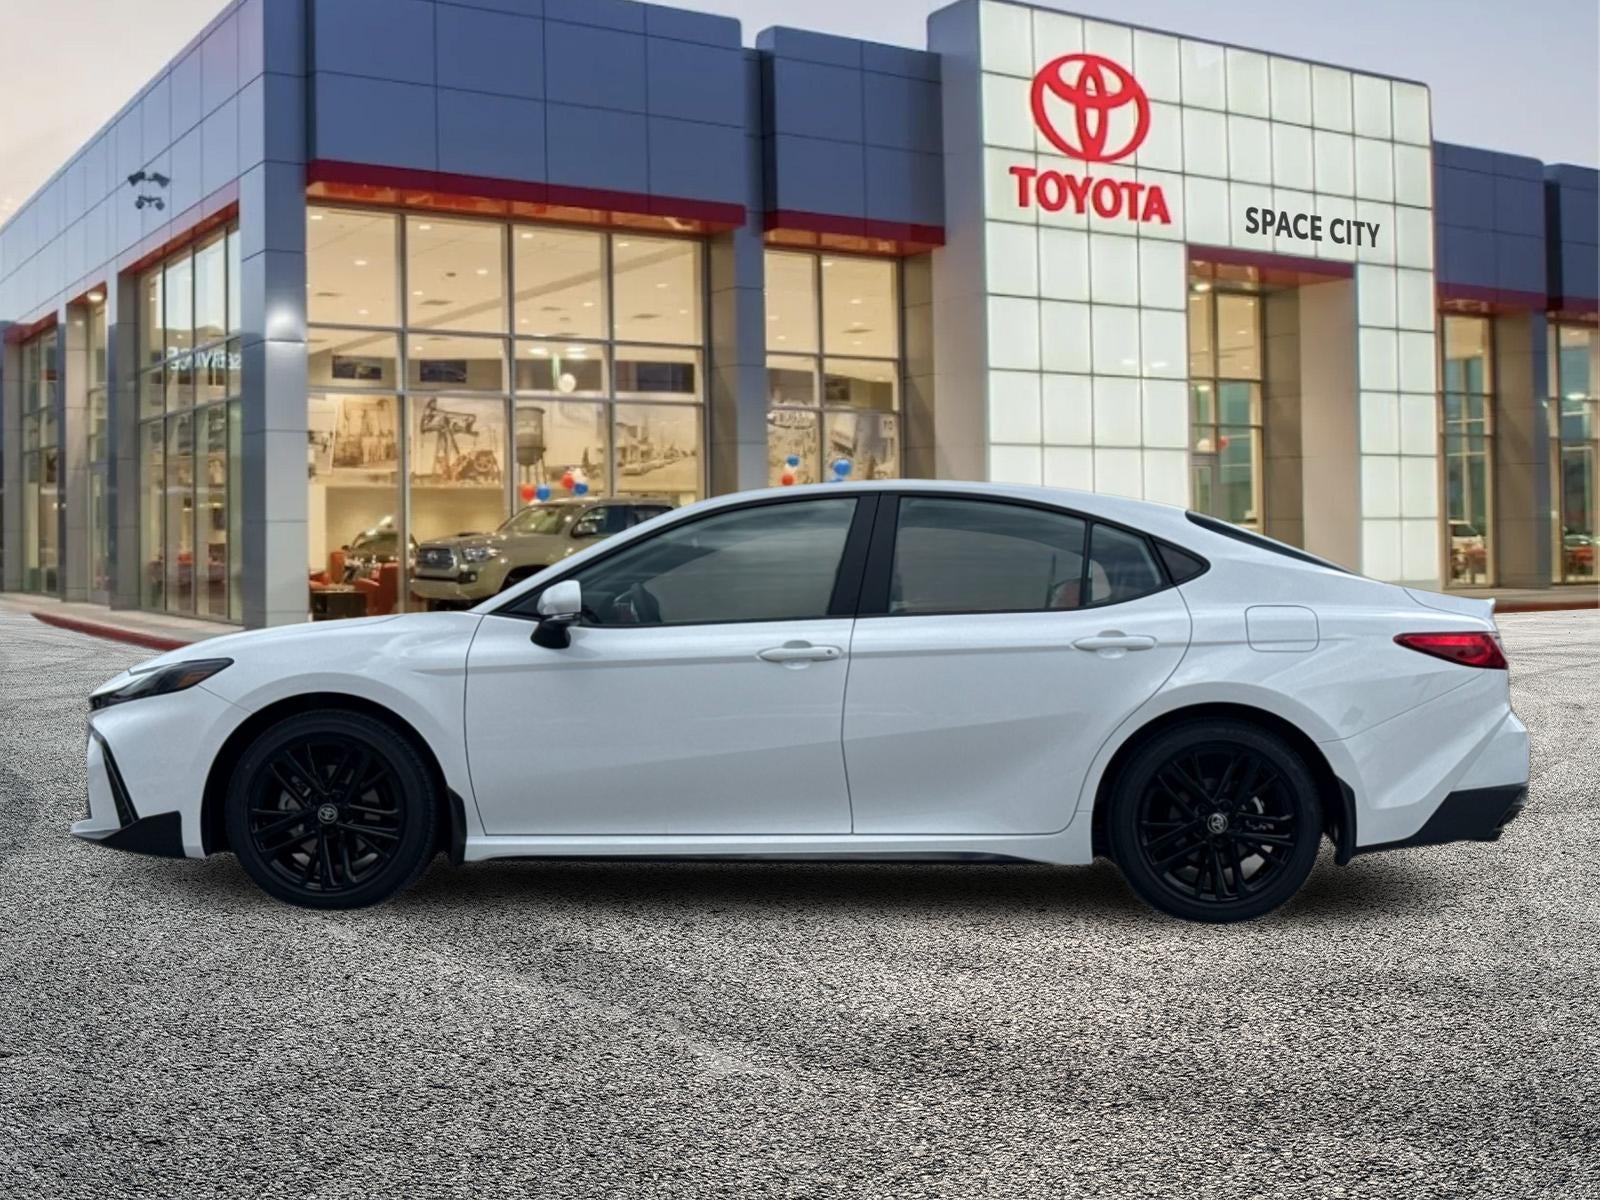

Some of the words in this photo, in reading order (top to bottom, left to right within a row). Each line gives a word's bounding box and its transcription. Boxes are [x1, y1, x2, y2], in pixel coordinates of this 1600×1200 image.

[1009, 166, 1171, 224] TOYOTA
[1245, 206, 1322, 242] SPACE
[1329, 218, 1380, 248] CITY
